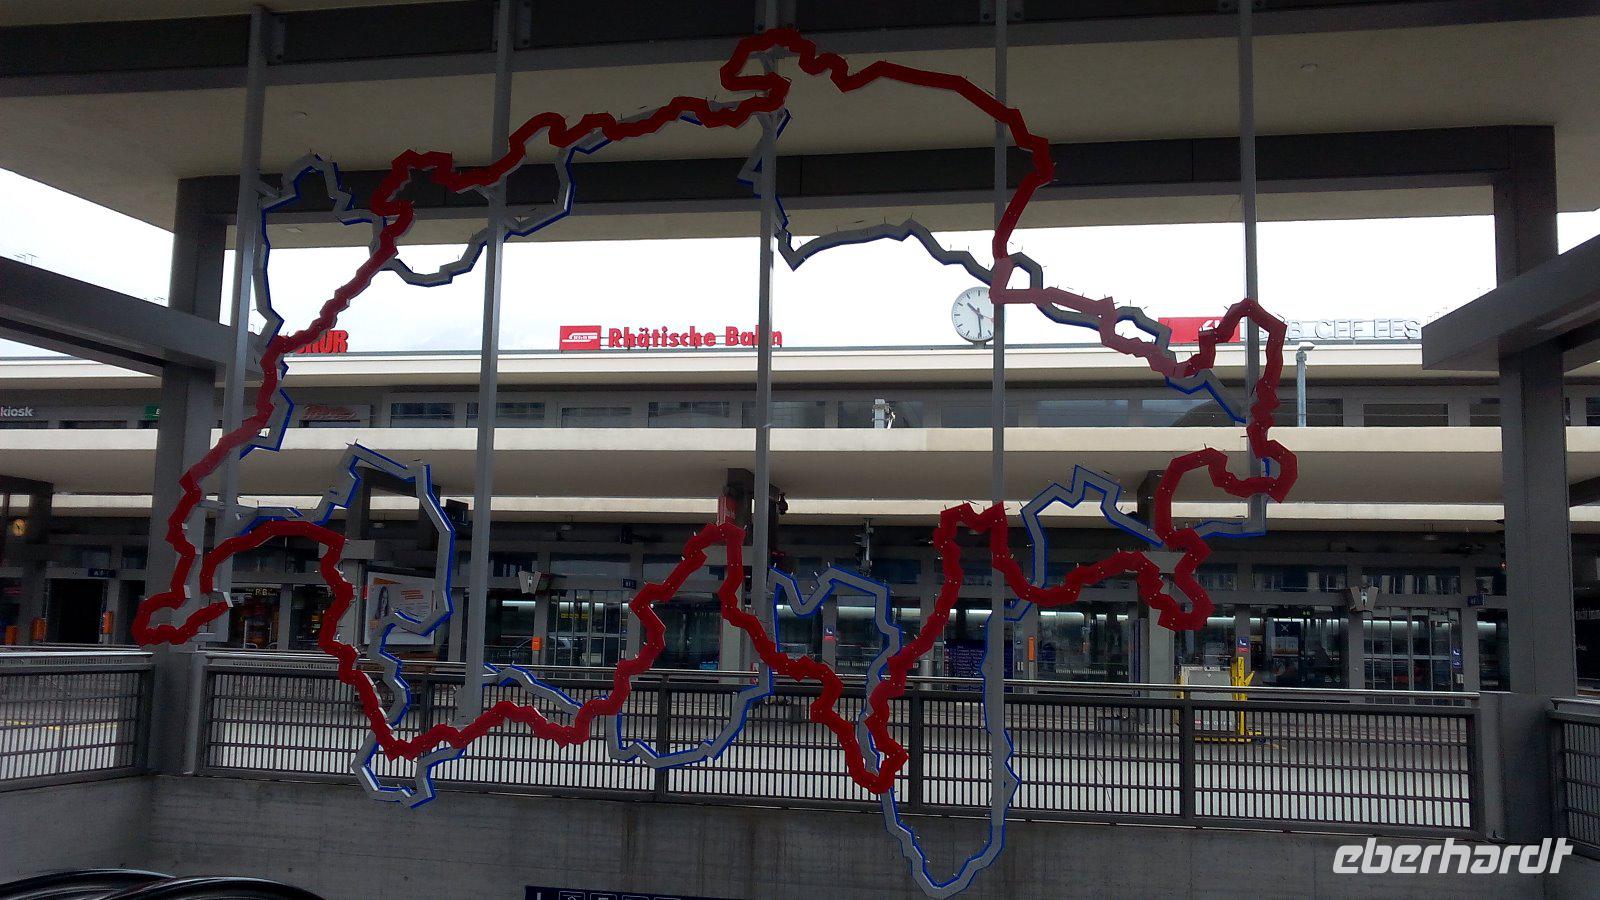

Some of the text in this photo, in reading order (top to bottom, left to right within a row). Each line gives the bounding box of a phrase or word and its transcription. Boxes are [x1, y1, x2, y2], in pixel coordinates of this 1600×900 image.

[608, 326, 717, 348] Rhätische
[1314, 319, 1363, 339] CFF
[0, 406, 33, 416] kiosk
